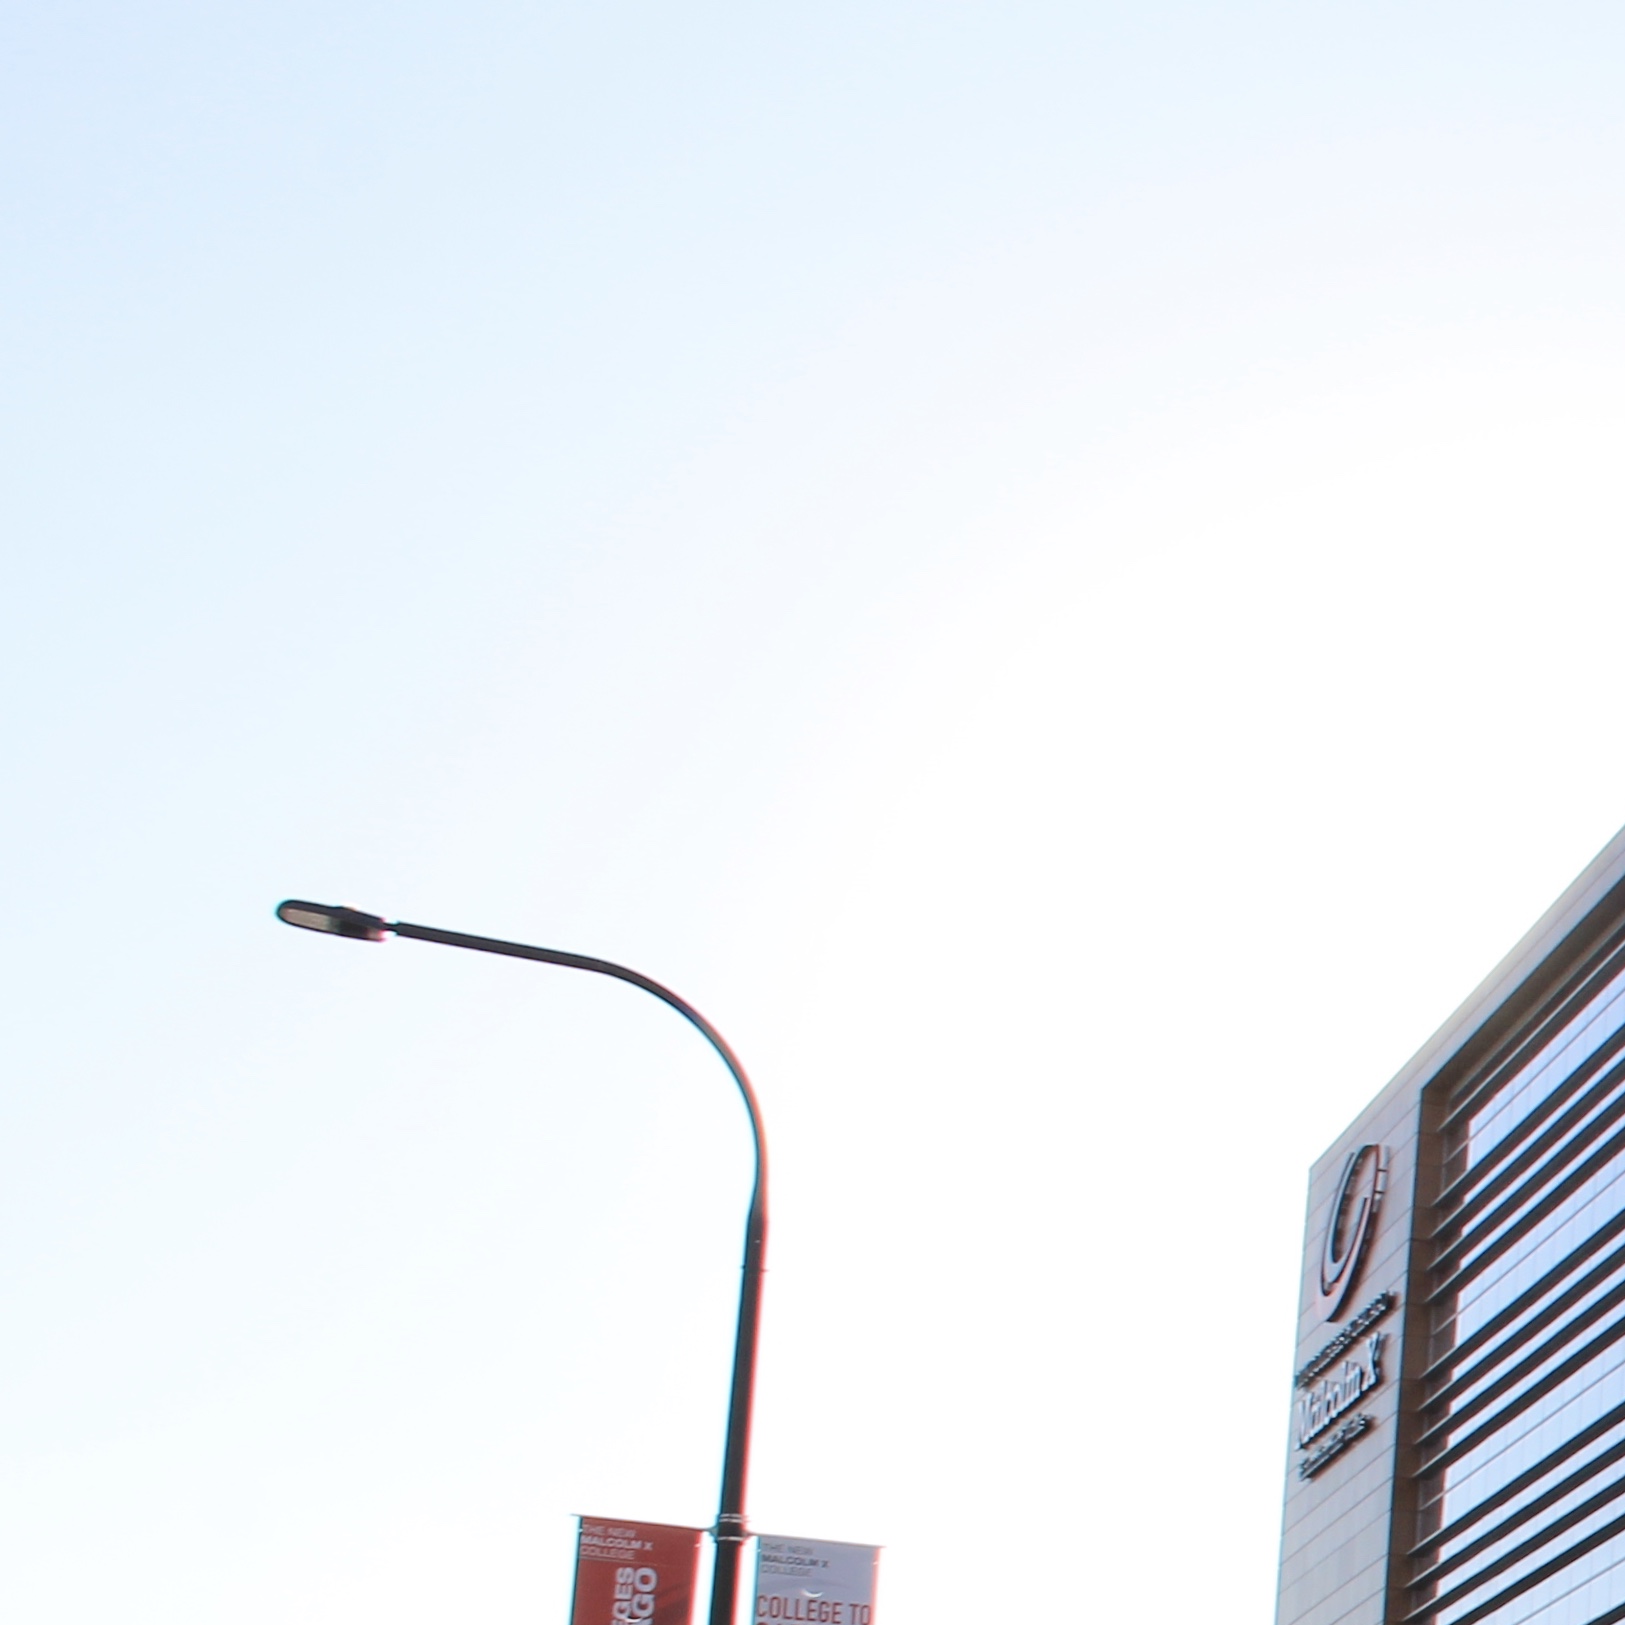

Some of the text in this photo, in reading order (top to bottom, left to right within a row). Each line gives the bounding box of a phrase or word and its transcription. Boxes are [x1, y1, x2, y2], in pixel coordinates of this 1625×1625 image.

[581, 1535, 642, 1549] MALCOLM
[756, 1595, 872, 1625] COLLEGE TO
